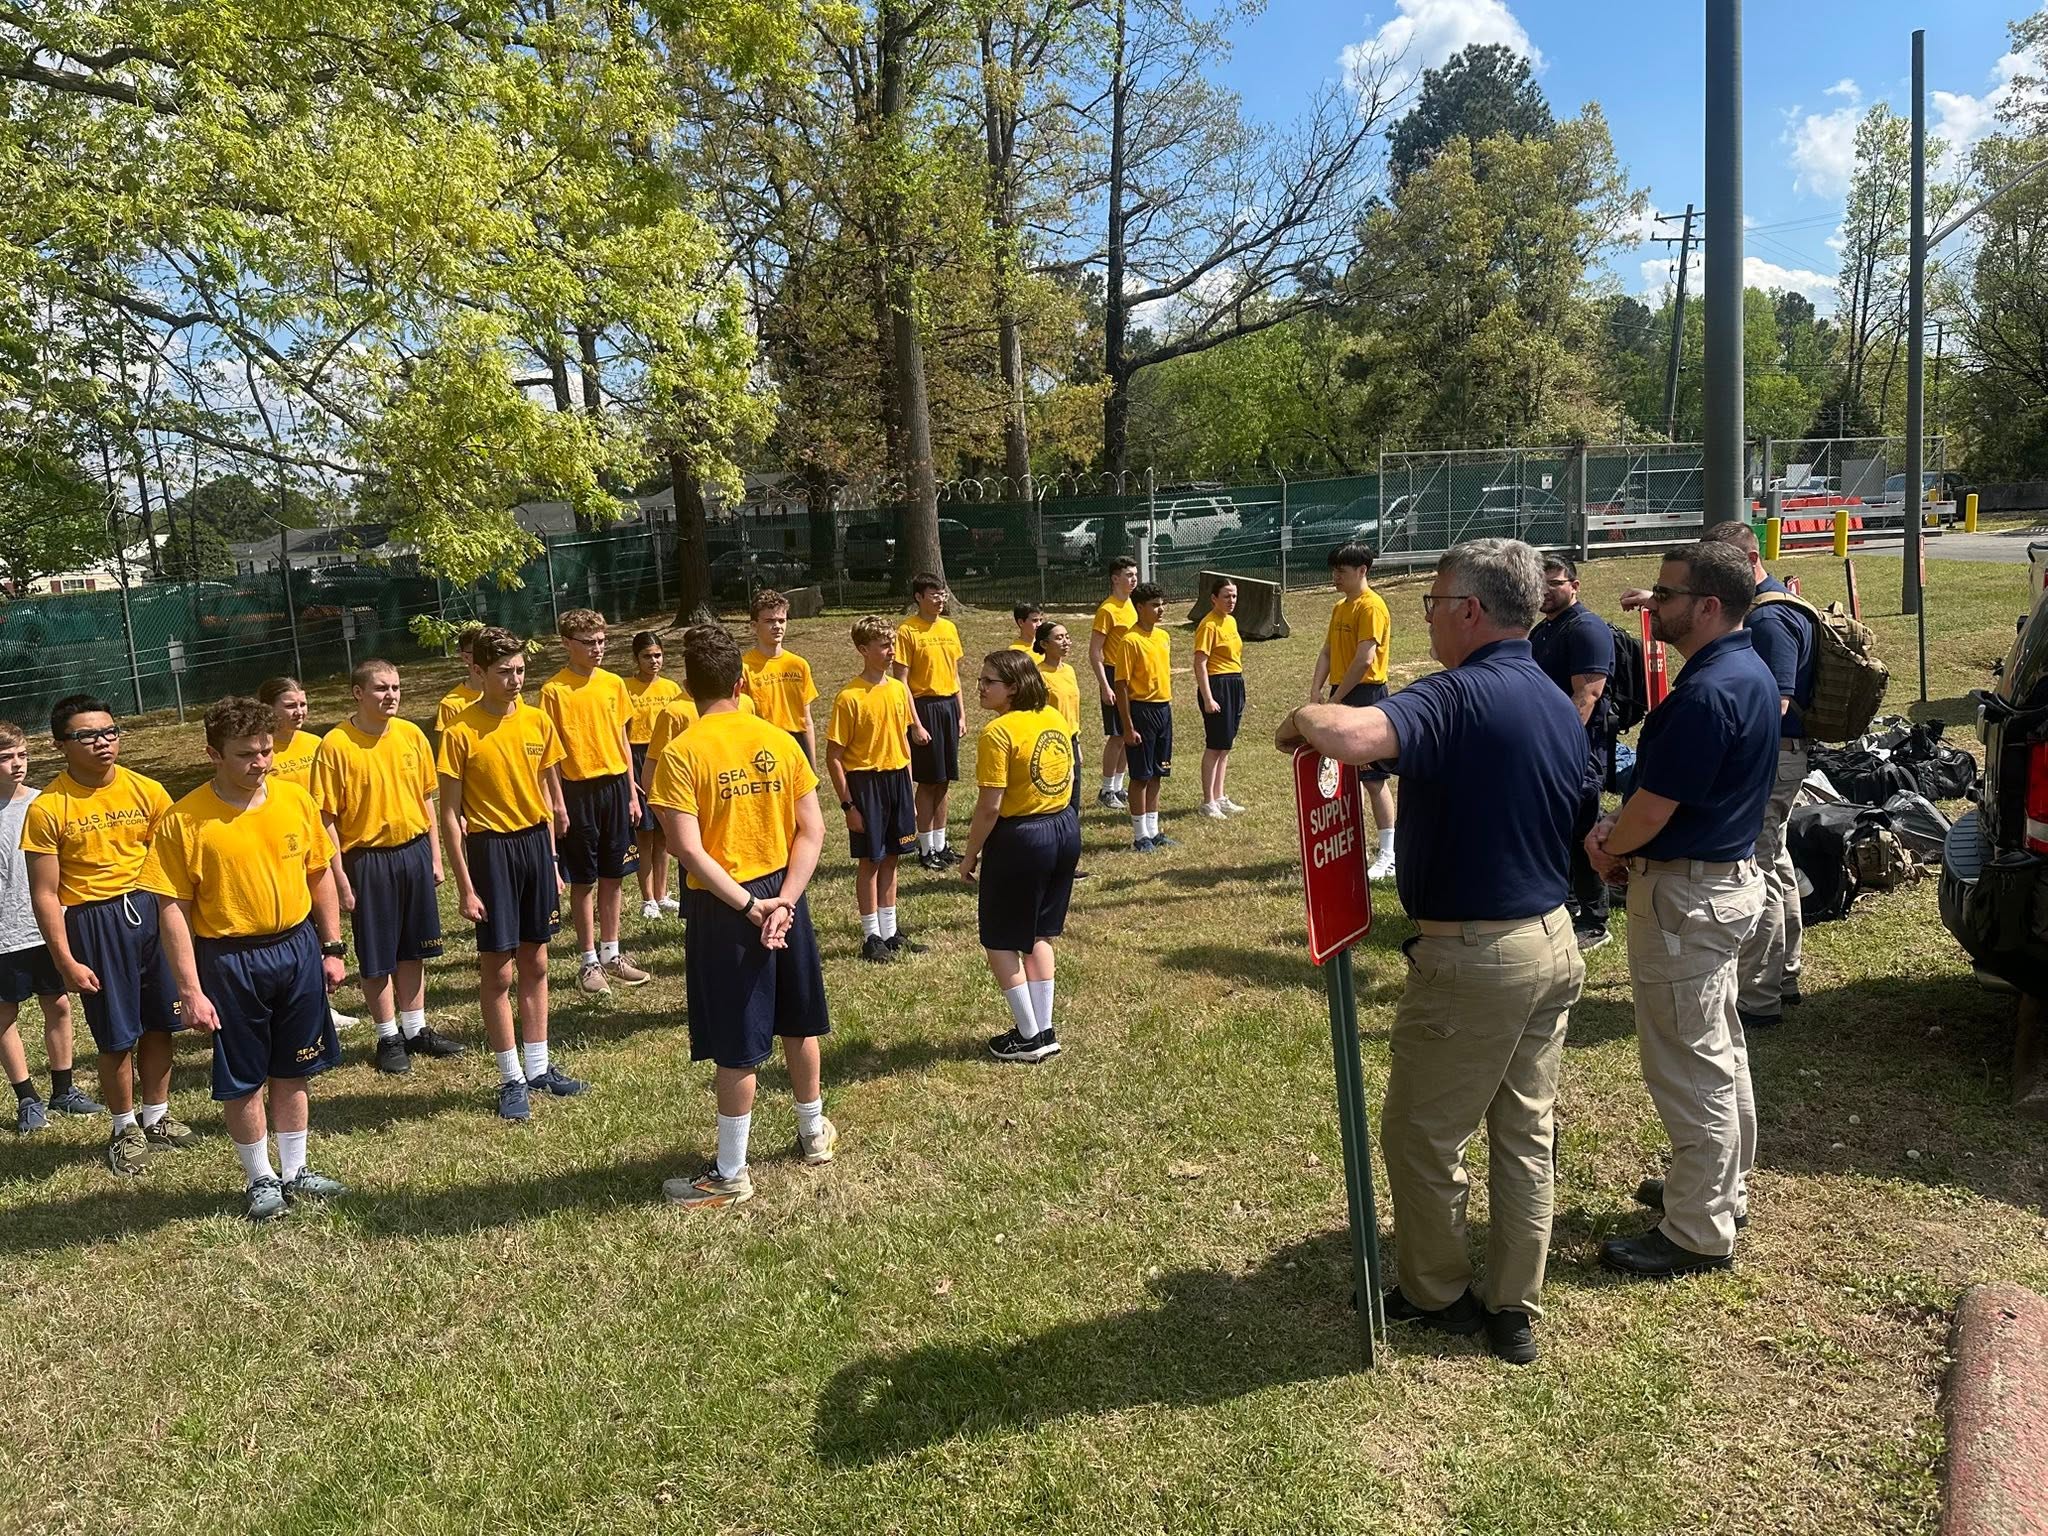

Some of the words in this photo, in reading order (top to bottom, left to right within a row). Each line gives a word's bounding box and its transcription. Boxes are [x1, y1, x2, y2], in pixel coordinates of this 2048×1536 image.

[718, 768, 747, 784] SEA
[720, 780, 781, 800] CADETS
[78, 814, 103, 826] U.S.
[105, 809, 149, 821] NAVAL
[1310, 793, 1351, 835] SUPPLY
[80, 825, 97, 834] SEA
[98, 820, 123, 830] CADET
[1313, 826, 1354, 869] CHIEF
[296, 1046, 315, 1056] SEA
